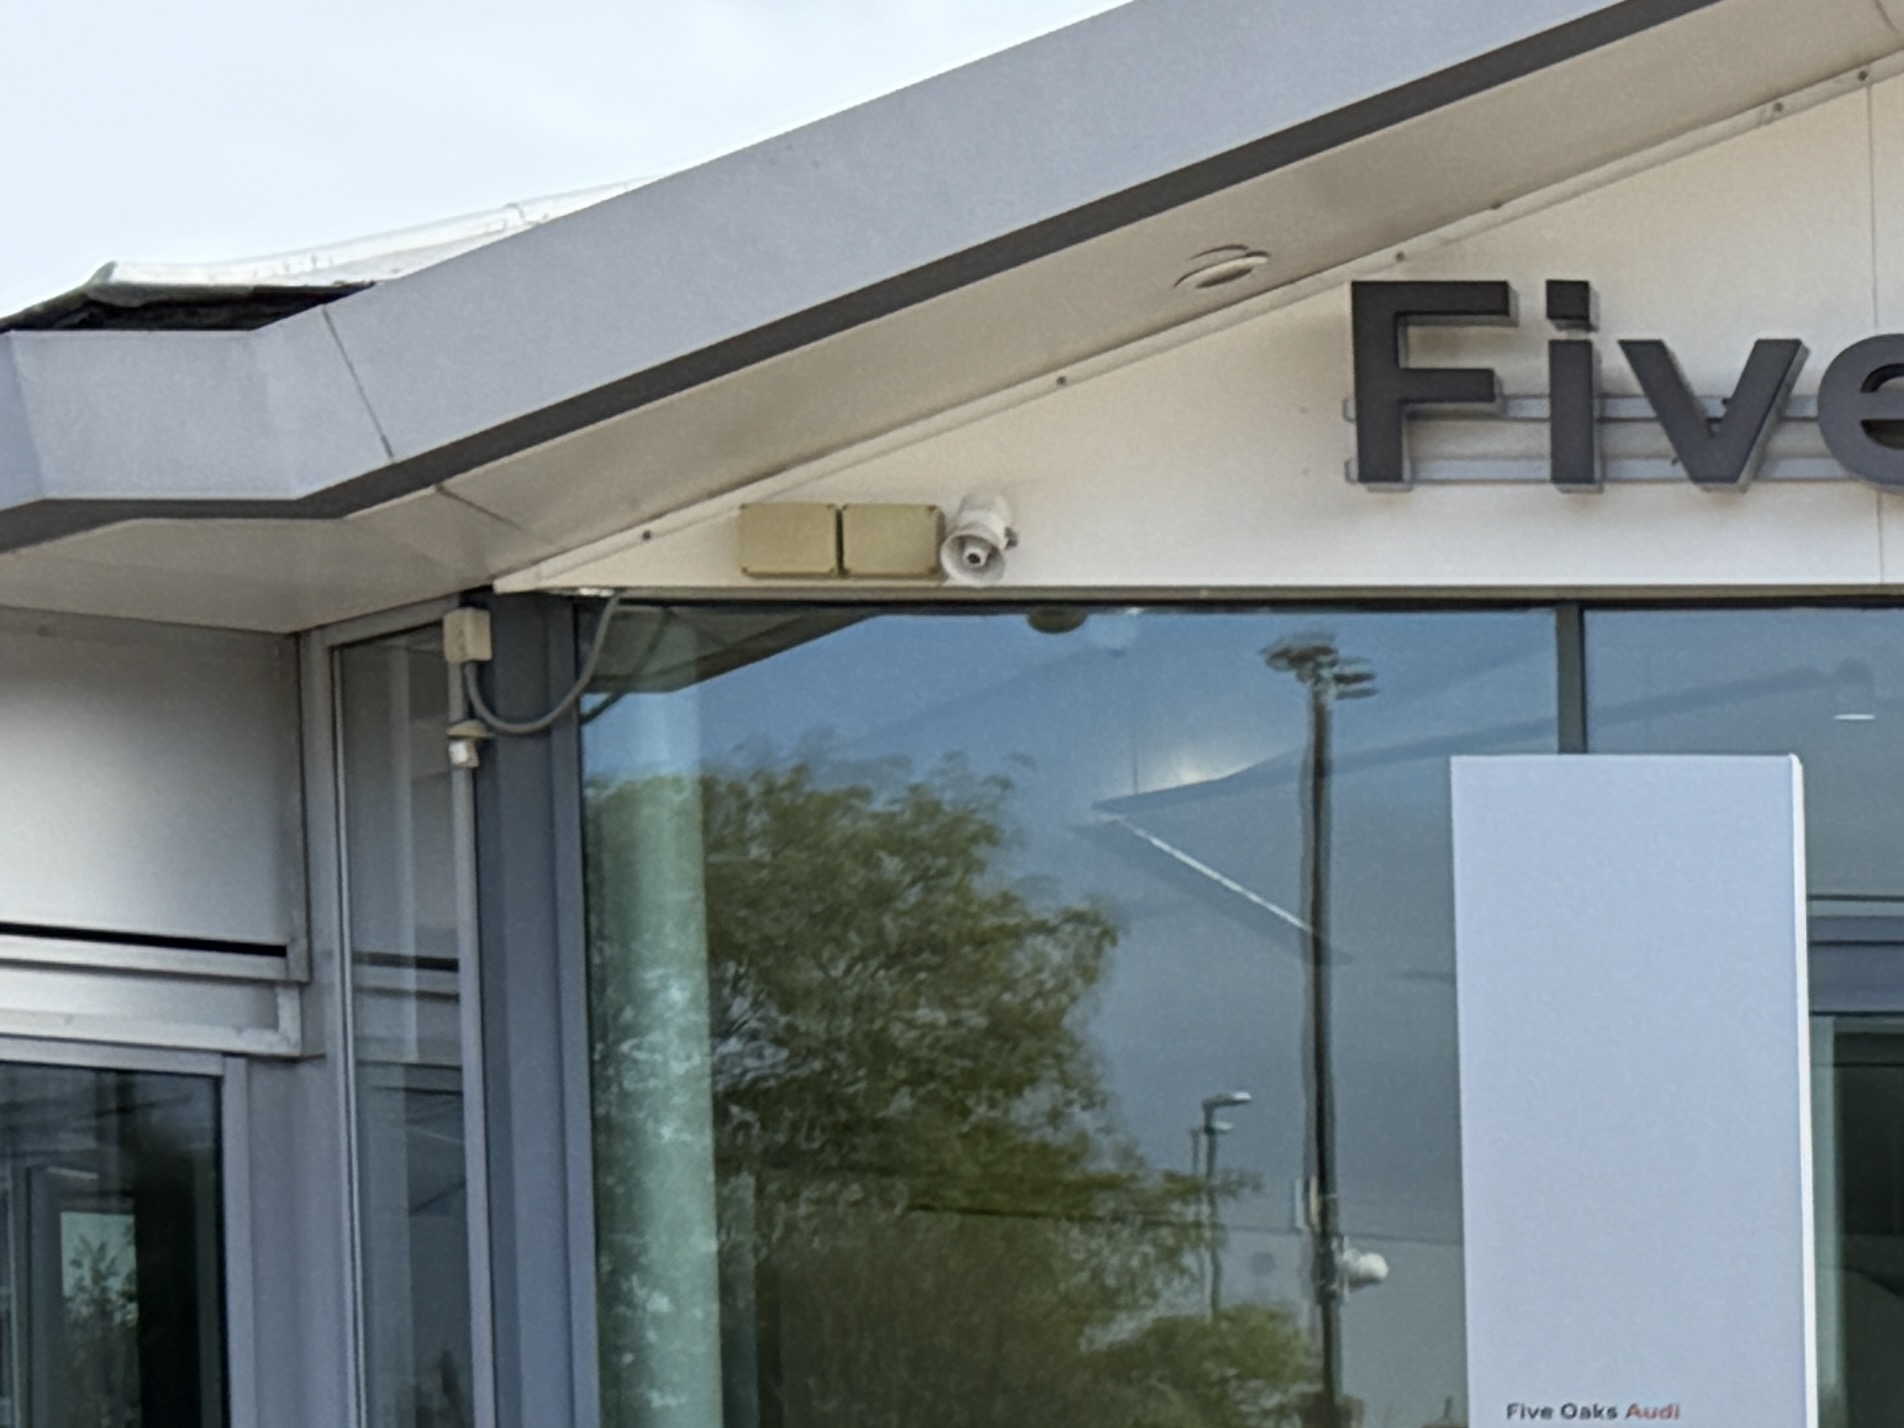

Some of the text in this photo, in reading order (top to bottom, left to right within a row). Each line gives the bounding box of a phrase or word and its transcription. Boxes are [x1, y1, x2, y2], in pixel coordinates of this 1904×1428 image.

[1506, 1402, 1681, 1420] Five Oaks Audi
